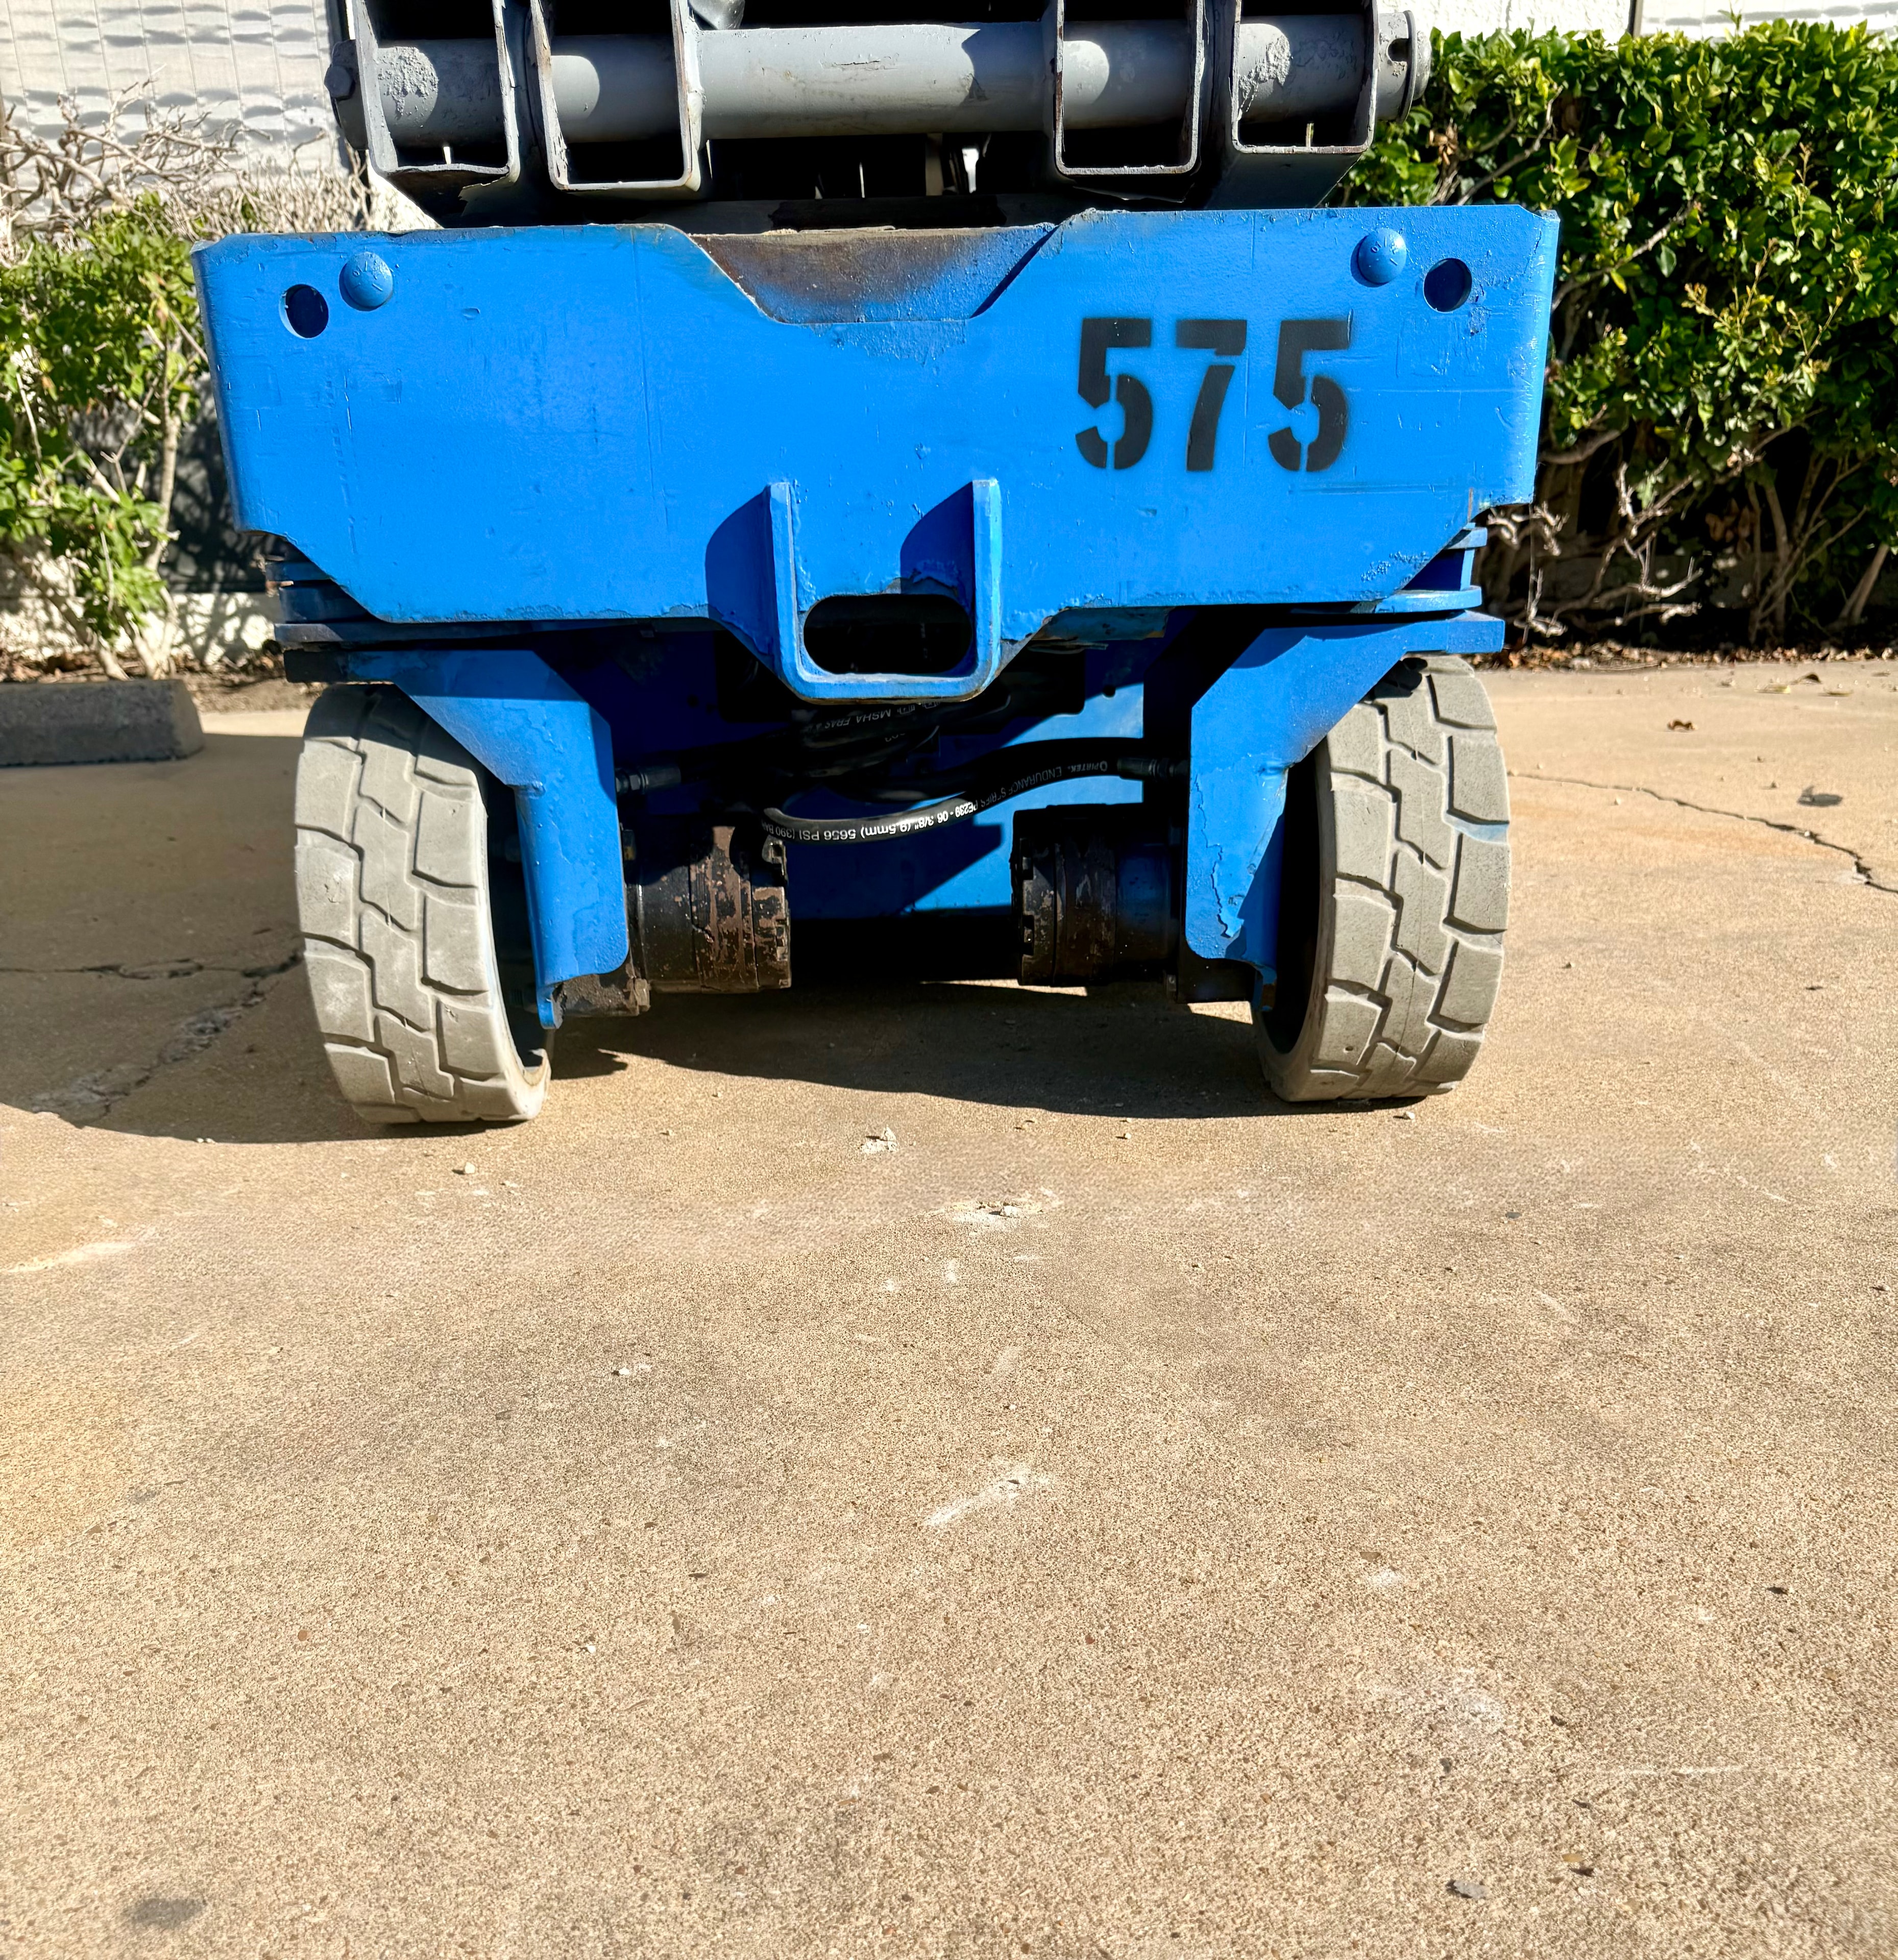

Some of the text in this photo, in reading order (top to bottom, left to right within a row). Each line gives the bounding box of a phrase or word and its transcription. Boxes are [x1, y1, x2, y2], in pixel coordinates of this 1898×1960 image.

[1075, 317, 1350, 472] 575
[856, 708, 891, 724] MSHA
[1009, 766, 1062, 795] ENDURANCE
[955, 800, 978, 818] PE239
[937, 811, 949, 824] 06
[775, 826, 795, 840] (390
[799, 830, 820, 841] PSI
[823, 829, 857, 841] 5656
[860, 820, 911, 838] (9.5mm)
